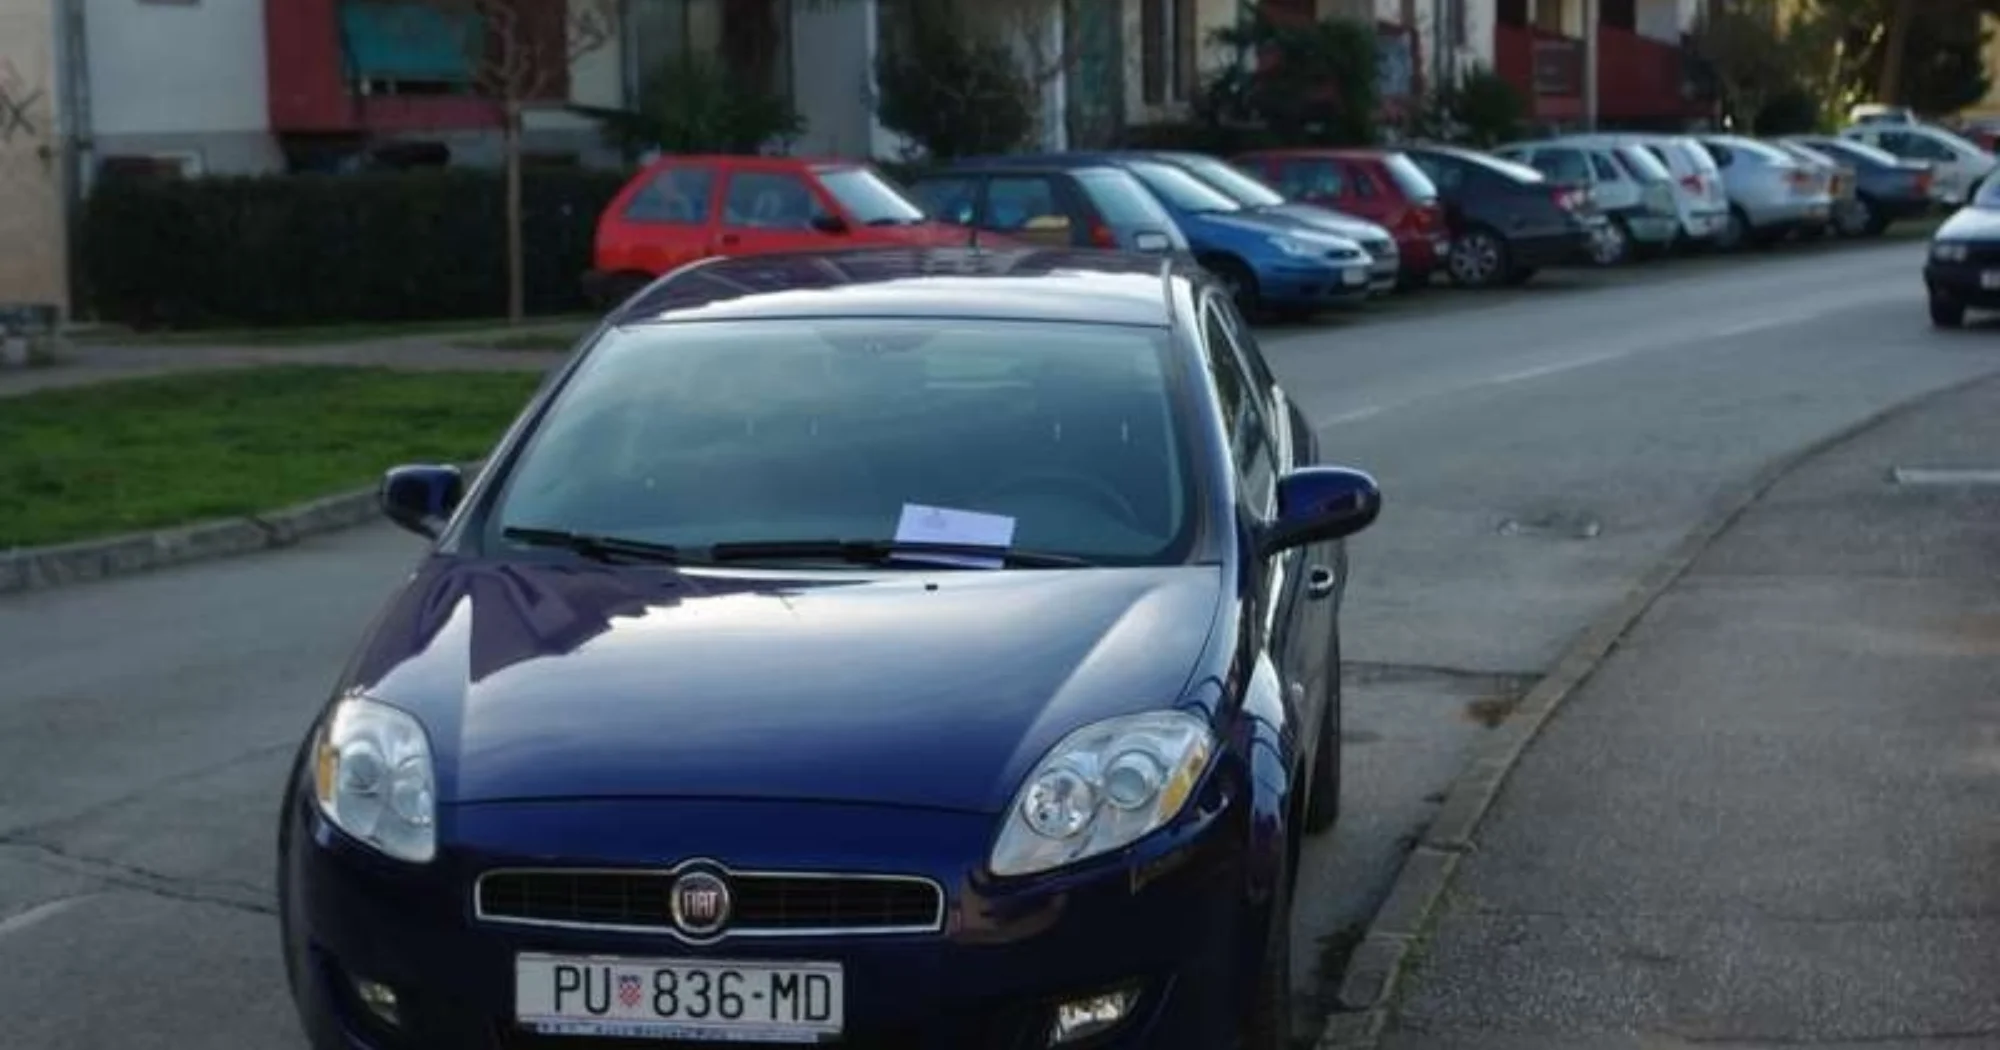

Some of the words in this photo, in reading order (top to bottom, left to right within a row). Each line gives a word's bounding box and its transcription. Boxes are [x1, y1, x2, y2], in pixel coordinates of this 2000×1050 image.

[684, 891, 718, 917] FIAT
[554, 965, 611, 1015] PU
[653, 968, 830, 1021] 836-MD
